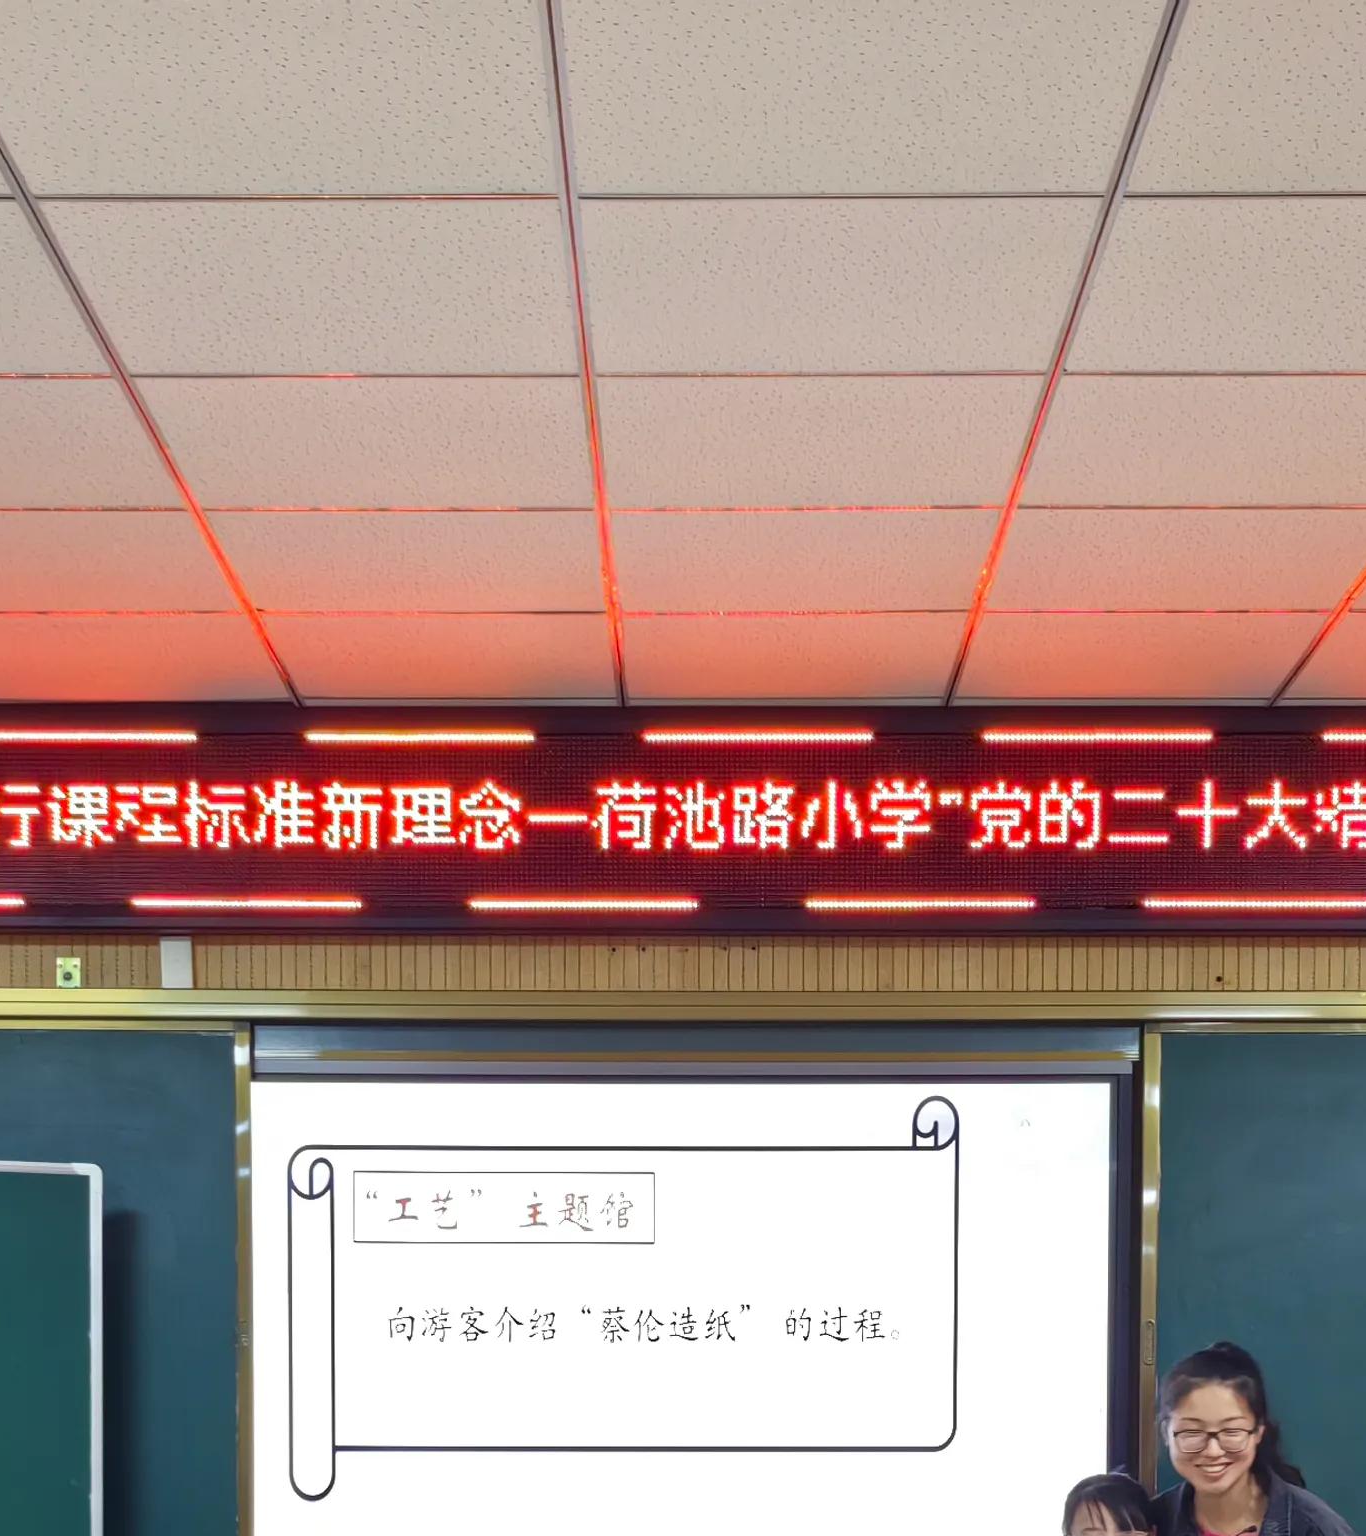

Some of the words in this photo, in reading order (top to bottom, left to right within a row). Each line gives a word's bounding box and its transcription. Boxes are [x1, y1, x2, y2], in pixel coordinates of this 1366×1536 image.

[387, 1303, 901, 1344] 向游客介绍“蔡伦造纸”的过程。
